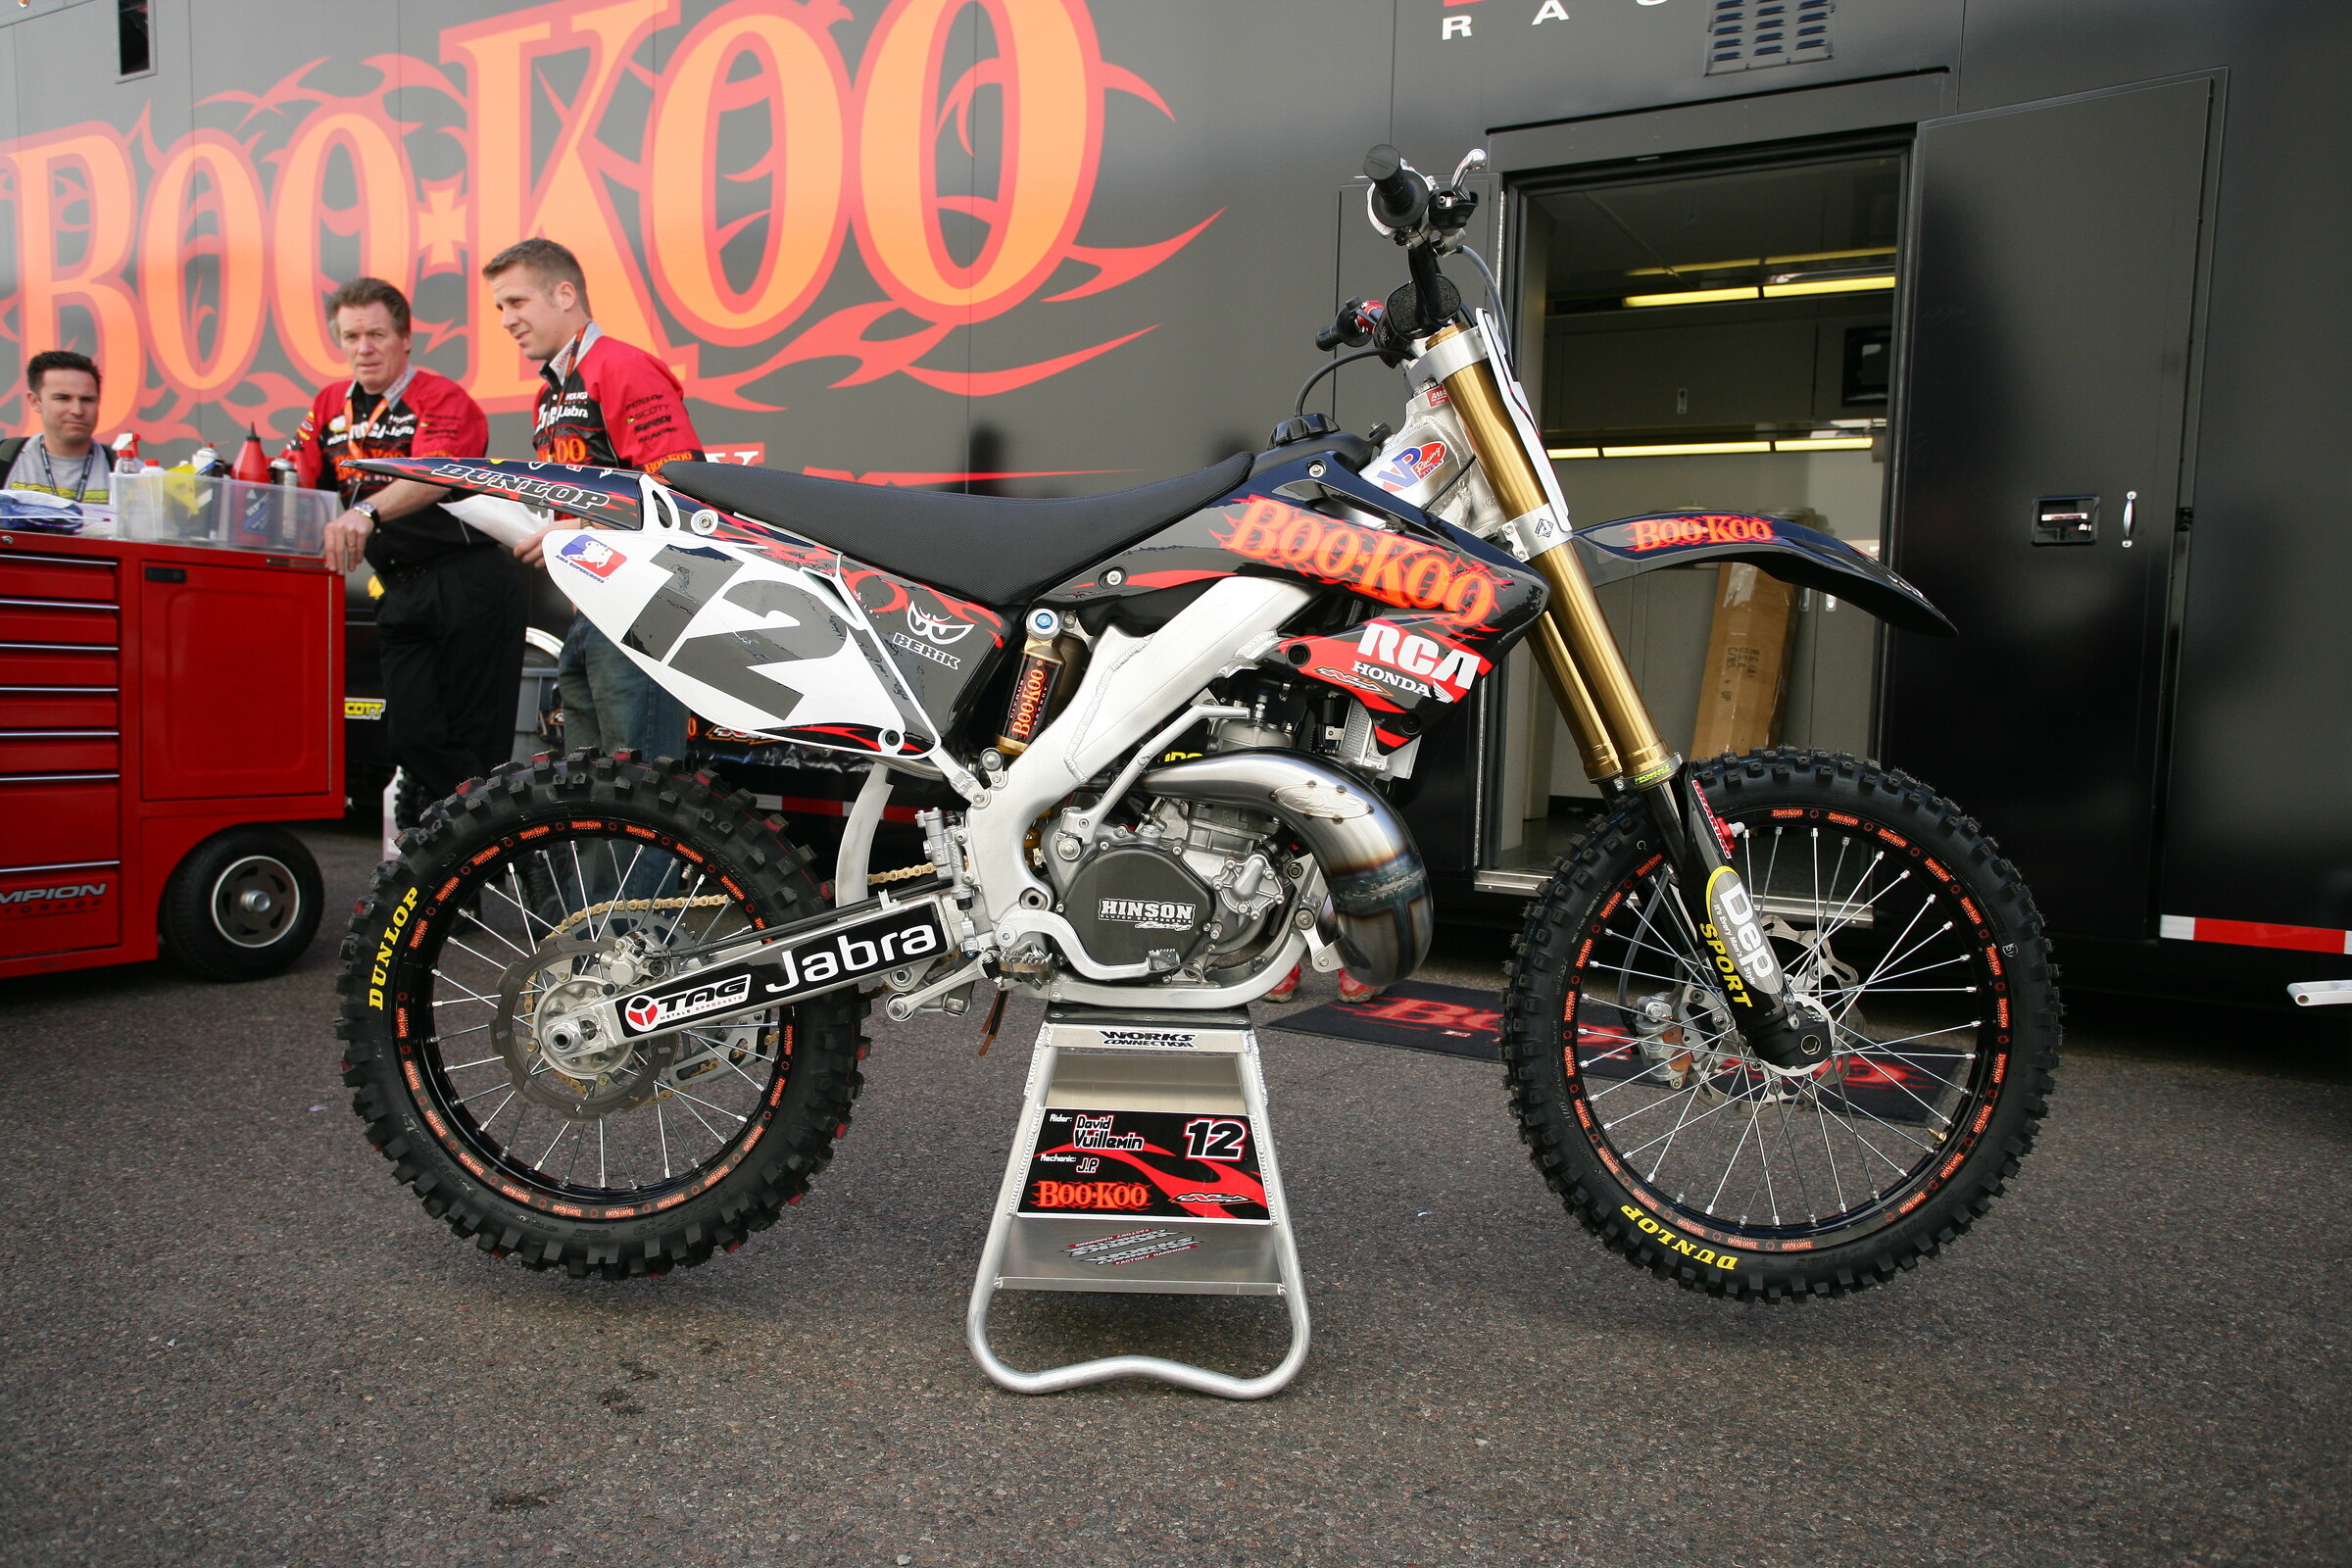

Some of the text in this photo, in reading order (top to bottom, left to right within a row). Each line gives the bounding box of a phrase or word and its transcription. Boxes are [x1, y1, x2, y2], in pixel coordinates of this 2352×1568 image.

[430, 463, 611, 510] DUNLOP
[555, 555, 605, 584] AMA SUPERCROSS
[620, 544, 849, 721] 12
[1356, 621, 1481, 689] RCA
[1350, 660, 1433, 699] HONDA
[345, 702, 383, 716] COTT
[1100, 900, 1194, 920] HINSON
[368, 887, 418, 1010] DUNLOP
[1719, 882, 1775, 979] Dep
[1719, 913, 1732, 935] Every
[1728, 935, 1742, 959] Man's
[1743, 966, 1756, 985] Style
[765, 924, 937, 993] Jabra
[1699, 922, 1753, 1008] SPORT
[658, 975, 750, 1014] TAG
[660, 995, 744, 1020] METALS SPROCKETS
[1100, 1030, 1196, 1042] WORKS
[1102, 1039, 1196, 1049] CONNECTION
[1050, 1113, 1114, 1131] Rider: David
[1184, 1119, 1248, 1162] 12
[1040, 1153, 1077, 1163] Mechanic:
[1115, 1245, 1193, 1266] FACTORY HARDWARE
[1620, 1204, 1739, 1270] DUNLOP
